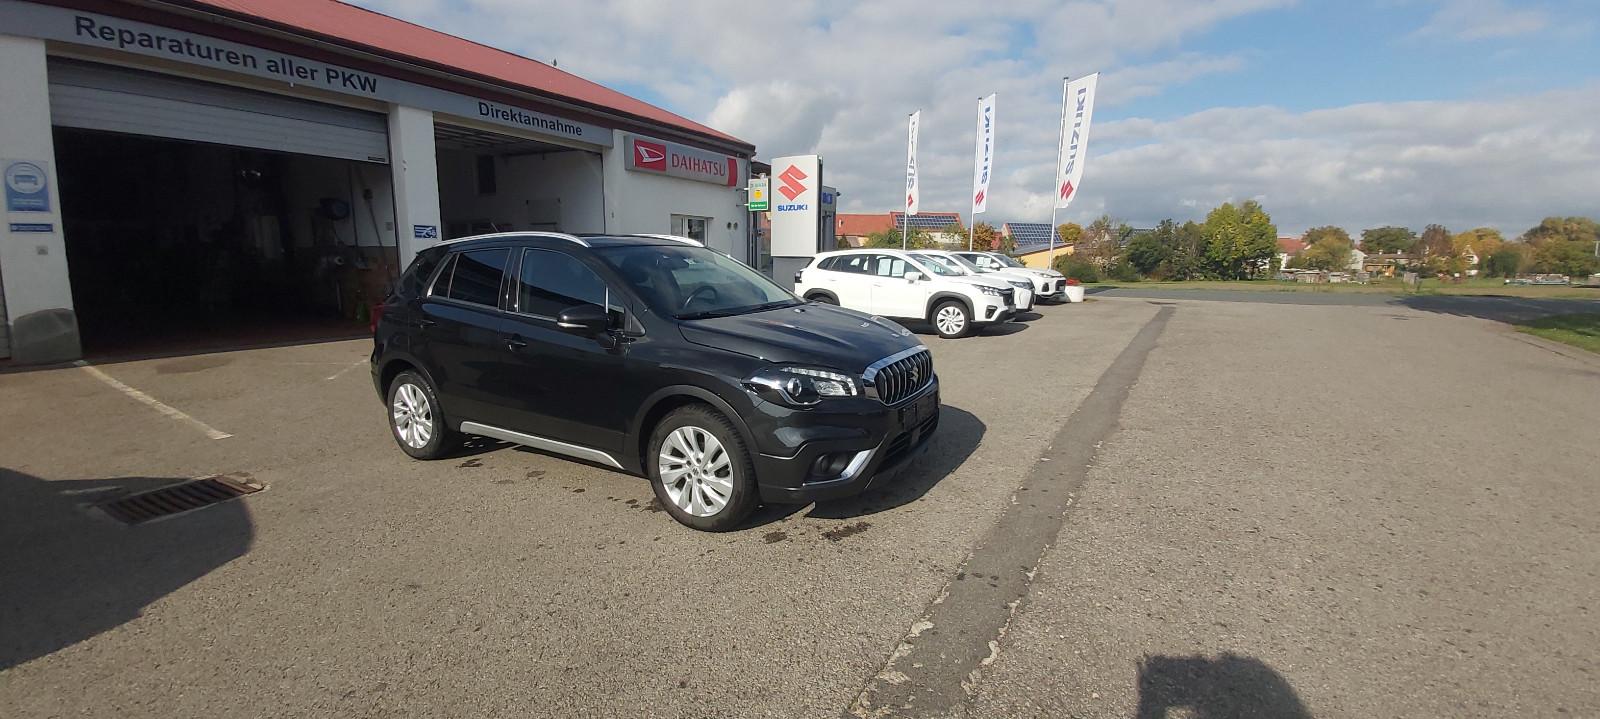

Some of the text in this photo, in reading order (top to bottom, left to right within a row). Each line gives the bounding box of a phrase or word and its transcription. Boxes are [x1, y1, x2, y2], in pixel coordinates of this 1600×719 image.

[75, 15, 377, 93] Reparaturen aller PKW
[478, 101, 582, 135] Direktannahme
[1065, 87, 1087, 175] SUZUKI
[671, 153, 726, 177] DAIHATSU
[777, 204, 808, 212] SUZUKI
